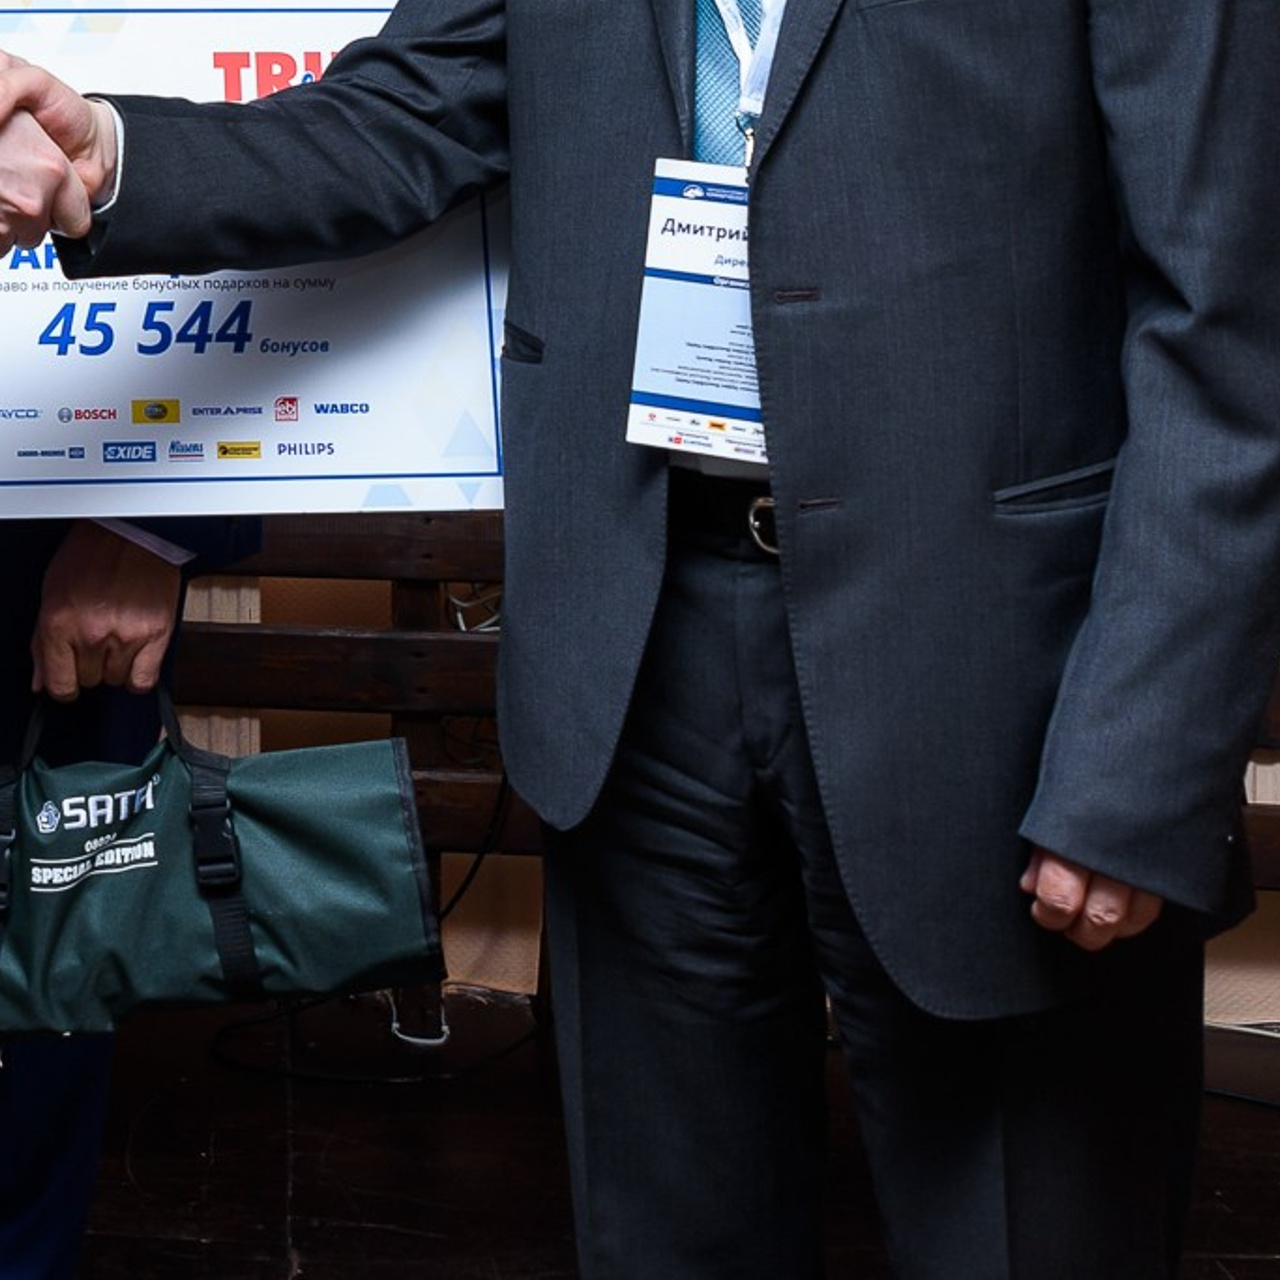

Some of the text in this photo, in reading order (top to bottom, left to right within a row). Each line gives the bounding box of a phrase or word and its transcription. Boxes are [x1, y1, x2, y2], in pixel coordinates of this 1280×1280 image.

[714, 254, 749, 268] Дире
[31, 281, 49, 291] на
[53, 279, 129, 294] получение
[133, 276, 200, 293] бонусных
[204, 277, 269, 292] подарков
[273, 278, 290, 289] на
[294, 276, 337, 292] сумму
[38, 300, 330, 357] 45 544 бонусов
[74, 409, 117, 420] BOSCH
[314, 403, 370, 415] WABCO
[105, 445, 154, 459] EXIDE
[277, 442, 334, 456] PHILIPS
[62, 780, 155, 830] SATA
[31, 860, 93, 885] SPECIAL
[94, 841, 155, 867] EDITION
